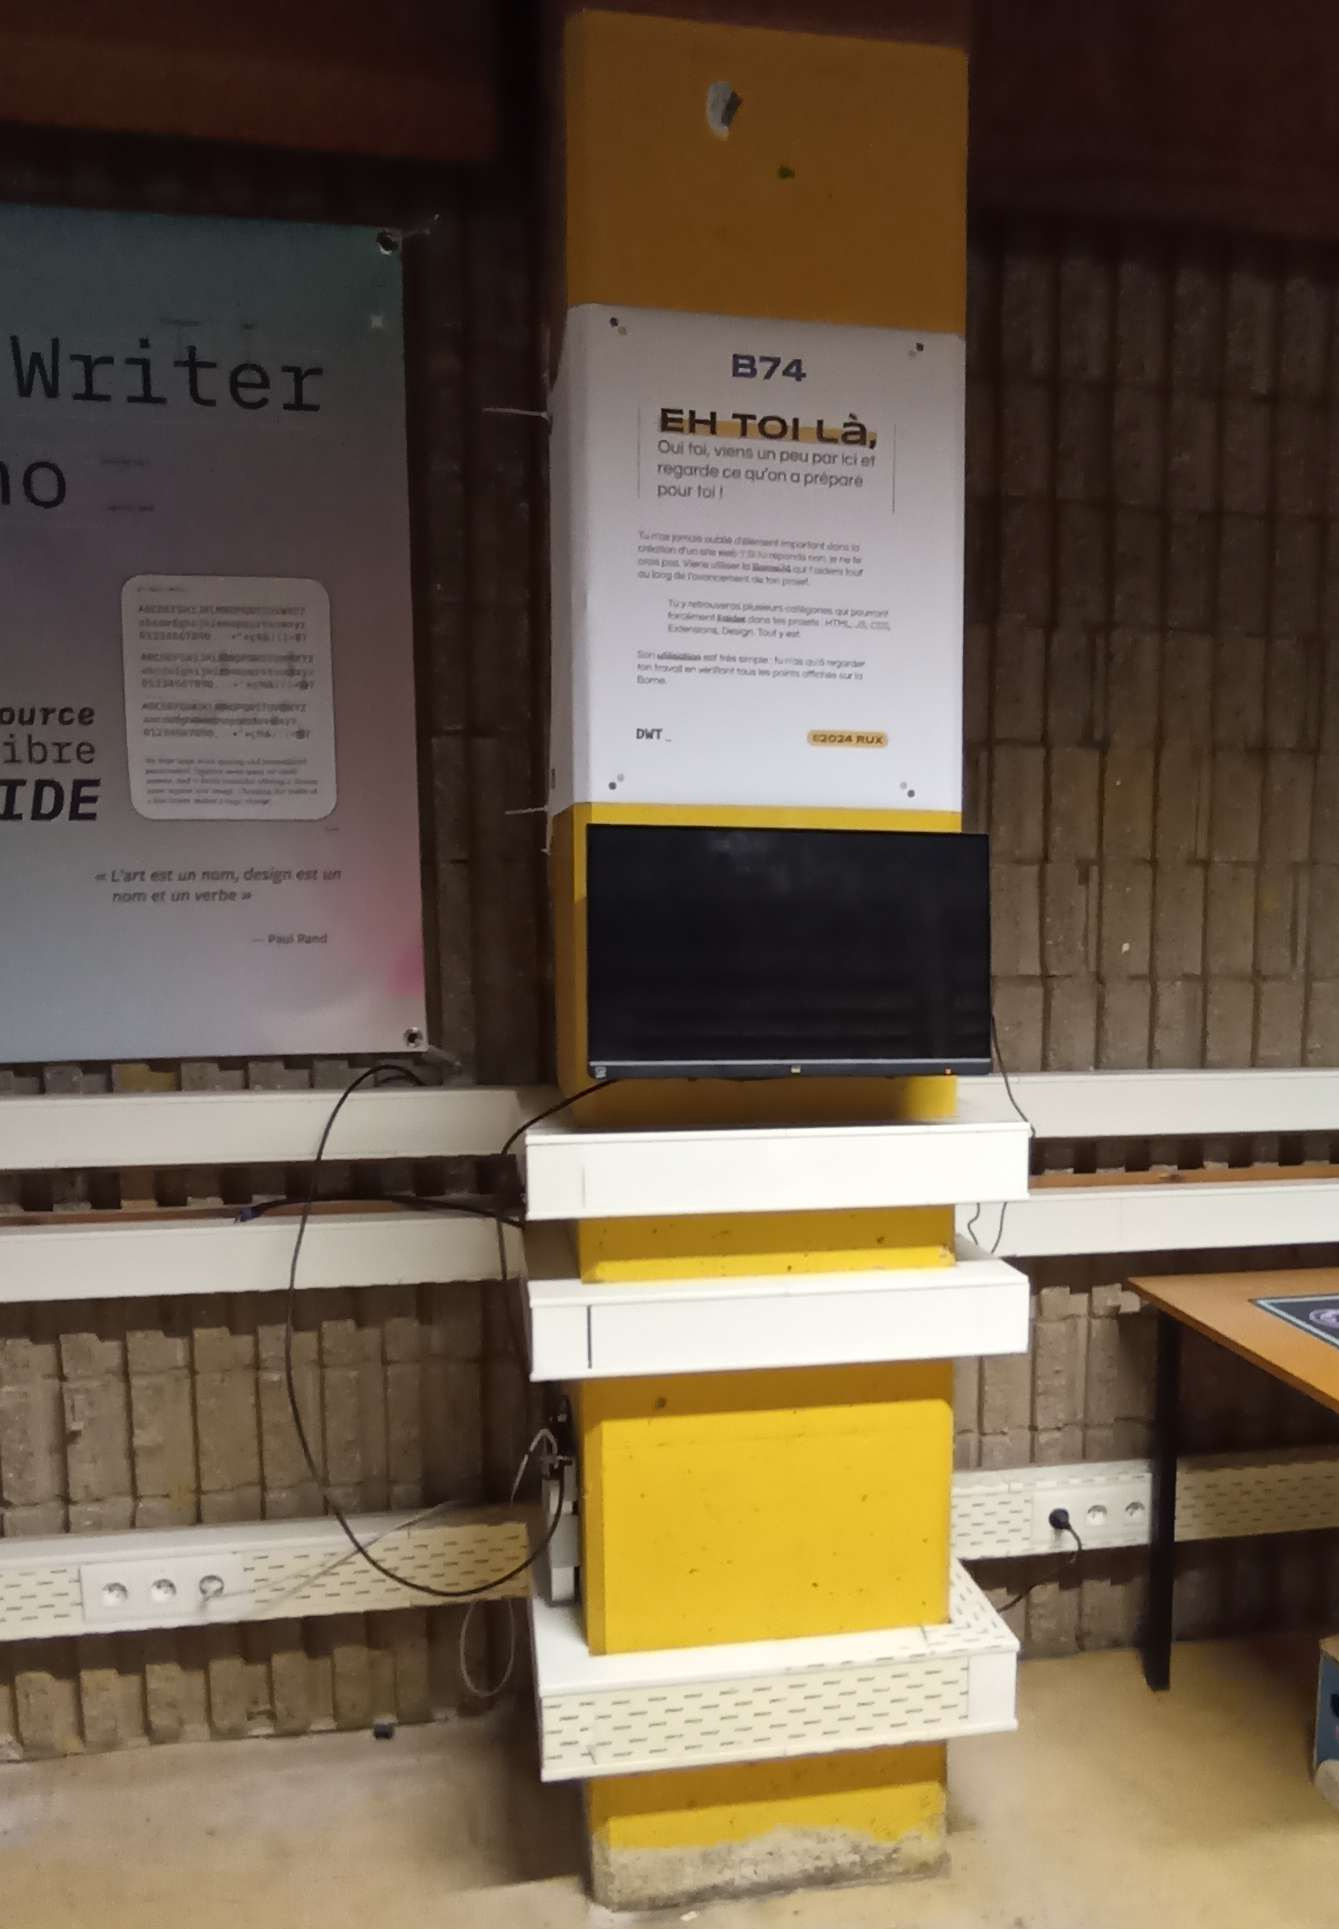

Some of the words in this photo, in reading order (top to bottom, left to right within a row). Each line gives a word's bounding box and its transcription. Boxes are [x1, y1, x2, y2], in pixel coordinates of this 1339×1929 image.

[10, 335, 324, 412] Writer
[731, 353, 806, 382] B74
[660, 408, 717, 436] EH
[732, 413, 799, 442] TOI
[657, 439, 685, 455] Oui
[688, 440, 711, 459] toi,
[714, 444, 753, 459] viens
[757, 448, 776, 461] un
[780, 449, 809, 466] peu
[812, 450, 838, 468] par
[841, 452, 858, 466] ici
[861, 453, 876, 468] et
[0, 460, 67, 510] o
[657, 461, 719, 480] regarde
[722, 467, 742, 479] ce
[744, 466, 787, 487] qu'on
[790, 472, 801, 485] a
[803, 471, 864, 490] préparé
[657, 483, 692, 500] pour
[696, 484, 716, 499] toi
[0, 706, 96, 727] ource
[3, 733, 96, 764] ibre
[856, 734, 884, 745] RUX
[0, 778, 102, 821] IDE
[111, 869, 146, 883] L'art
[150, 870, 173, 882] est
[178, 870, 197, 882] un
[202, 870, 239, 883] nom,
[243, 868, 292, 884] design
[295, 869, 319, 881] est
[323, 869, 342, 881] un
[112, 890, 147, 903] nom
[151, 890, 166, 903] et
[171, 890, 191, 902] un
[195, 889, 237, 902] verbe
[268, 934, 295, 945] Paul
[297, 933, 329, 945] Rand
